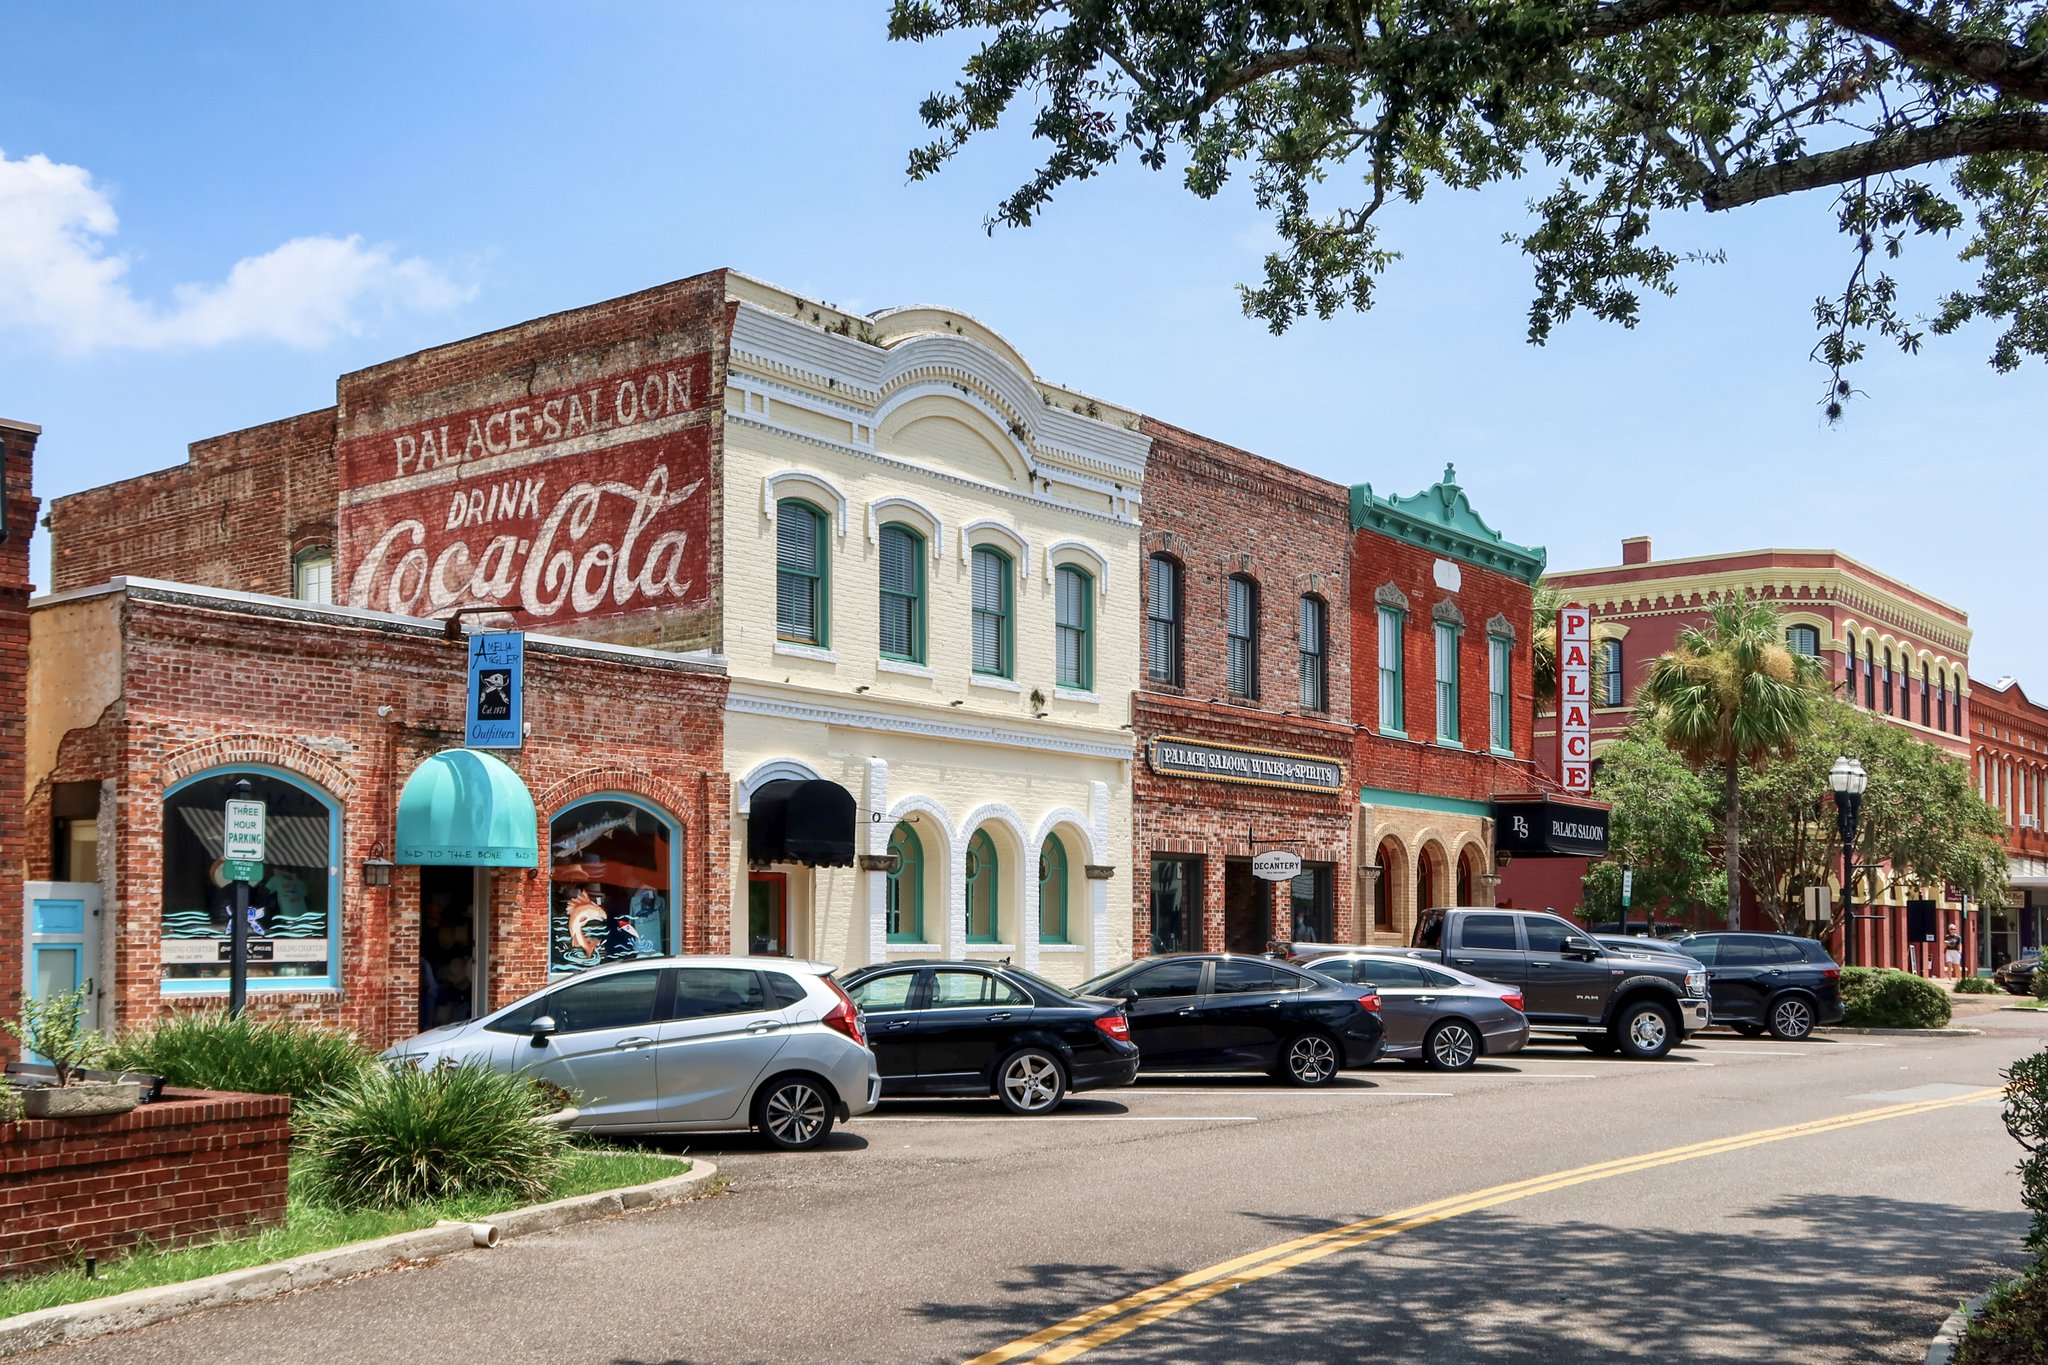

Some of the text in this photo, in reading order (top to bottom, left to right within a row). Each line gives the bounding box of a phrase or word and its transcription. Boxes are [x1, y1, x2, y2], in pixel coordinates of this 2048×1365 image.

[394, 366, 693, 478] PALACE SALOON
[445, 478, 545, 531] DRINK
[348, 463, 704, 618] Coca-Cola
[1566, 615, 1587, 787] PALACE
[472, 724, 515, 744] Outfitters
[1163, 748, 1206, 767] PALACE
[1208, 753, 1248, 772] SALOON
[1251, 758, 1285, 775] WINES
[1295, 765, 1332, 781] SPIRITS
[233, 807, 259, 816] THREE
[234, 821, 256, 829] HOUR
[1552, 821, 1604, 840] PALACE SALOON
[229, 833, 261, 845] PARKING
[427, 850, 443, 858] TO
[448, 850, 472, 859] THE
[478, 851, 501, 860] BONE
[1254, 862, 1300, 870] DECANTERY
